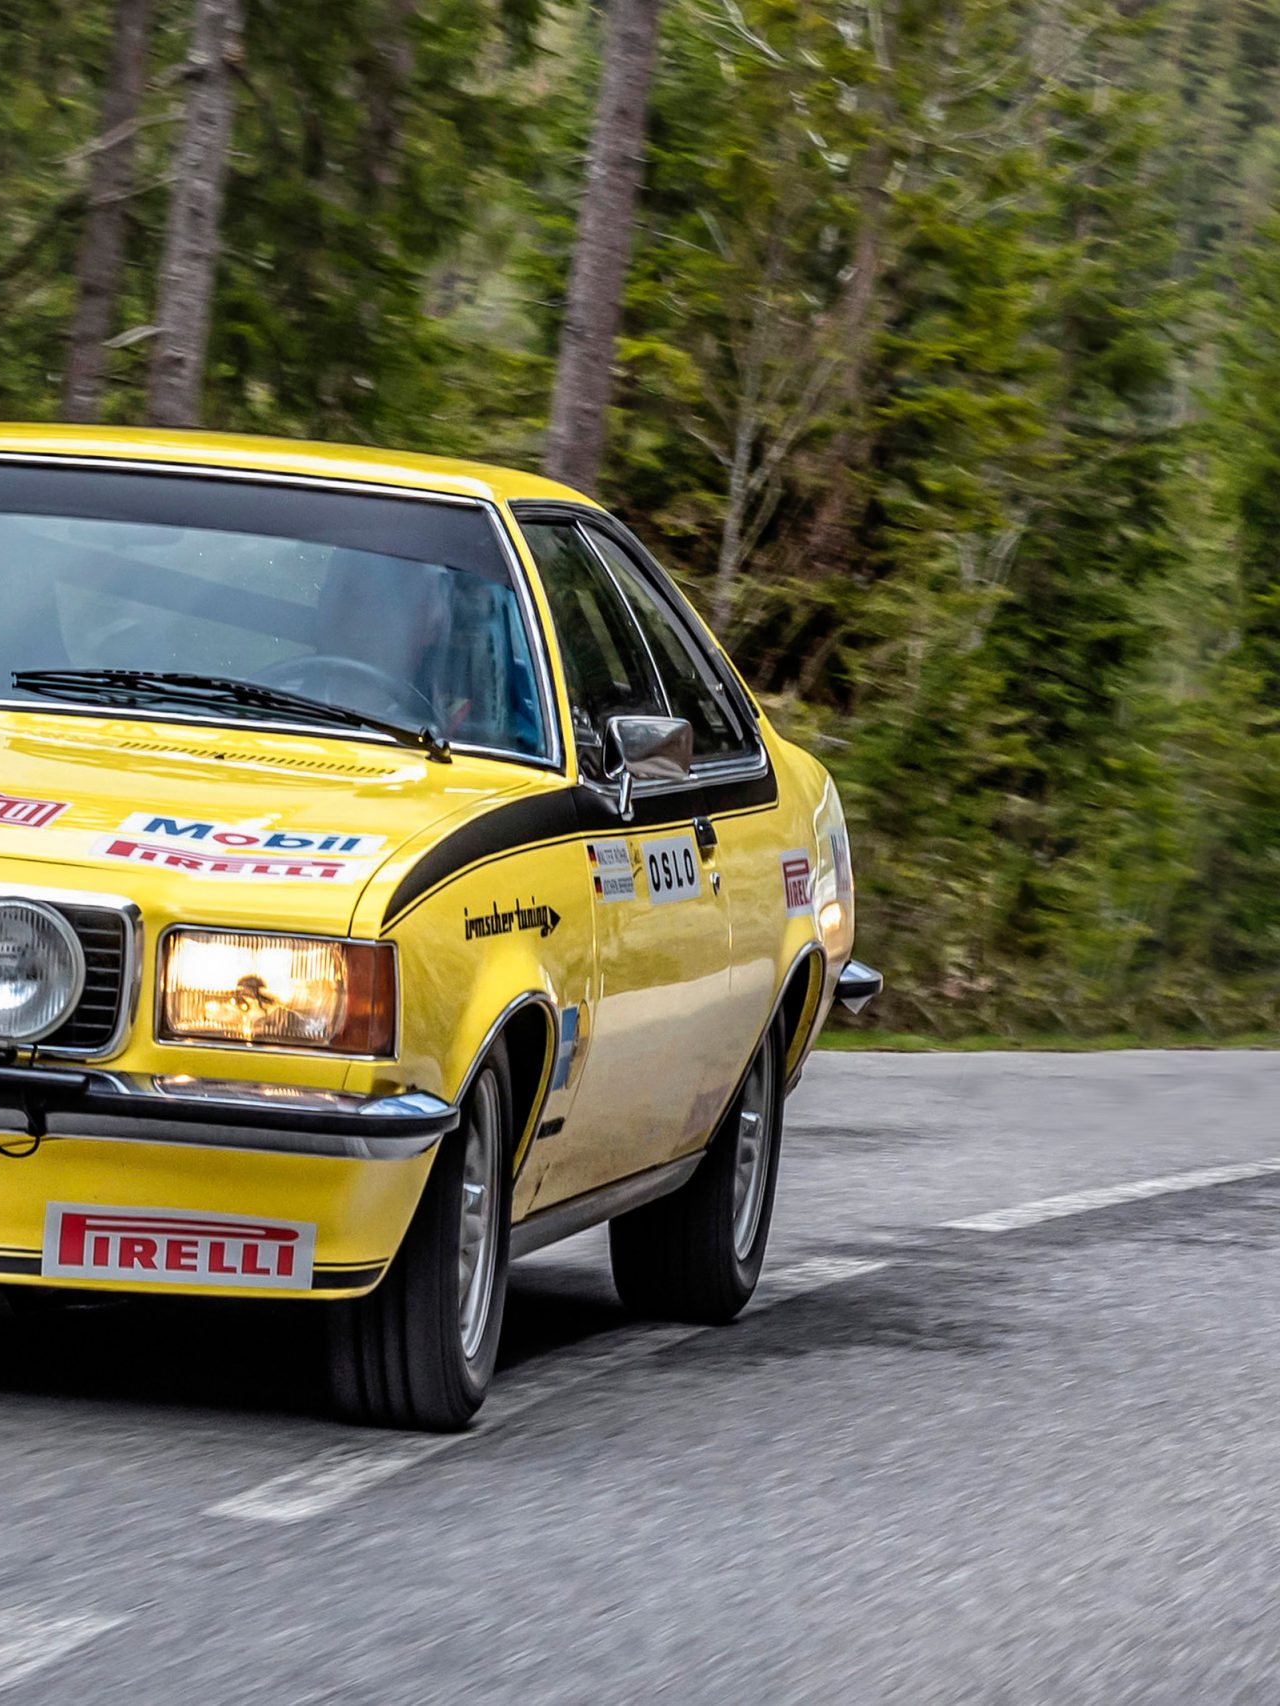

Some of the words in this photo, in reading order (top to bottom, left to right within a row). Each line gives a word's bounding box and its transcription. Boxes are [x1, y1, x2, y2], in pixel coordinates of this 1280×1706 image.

[143, 817, 361, 852] Mobil
[106, 840, 345, 878] PIRELLI
[649, 848, 695, 892] OSLO
[464, 901, 514, 941] irmscher
[514, 896, 550, 938] tuning
[58, 1212, 299, 1277] PIRELLI
